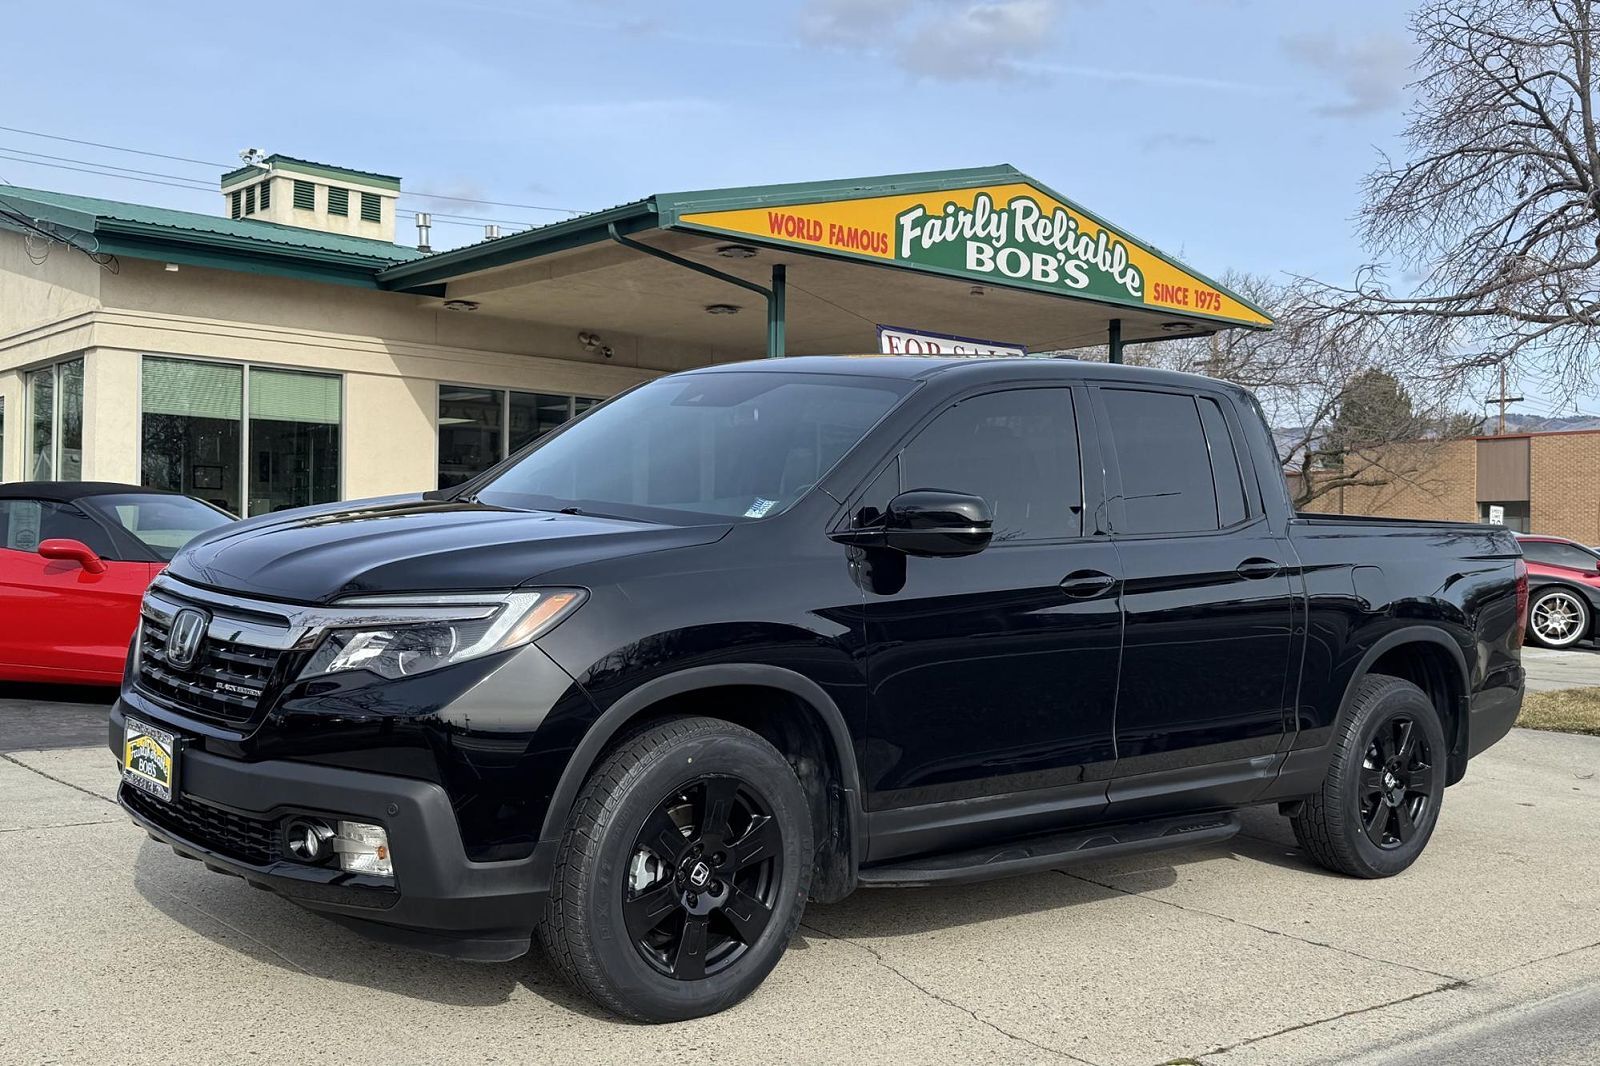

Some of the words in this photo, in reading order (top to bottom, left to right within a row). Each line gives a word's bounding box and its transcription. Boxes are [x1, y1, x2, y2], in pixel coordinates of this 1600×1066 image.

[767, 211, 823, 242] WORLD
[829, 223, 888, 254] FAMOUS
[900, 195, 1008, 259] Fairly
[1011, 199, 1142, 297] Reliable
[966, 240, 1090, 289] BOB'S
[1153, 282, 1189, 306] SINCE
[1194, 289, 1221, 311] 1975
